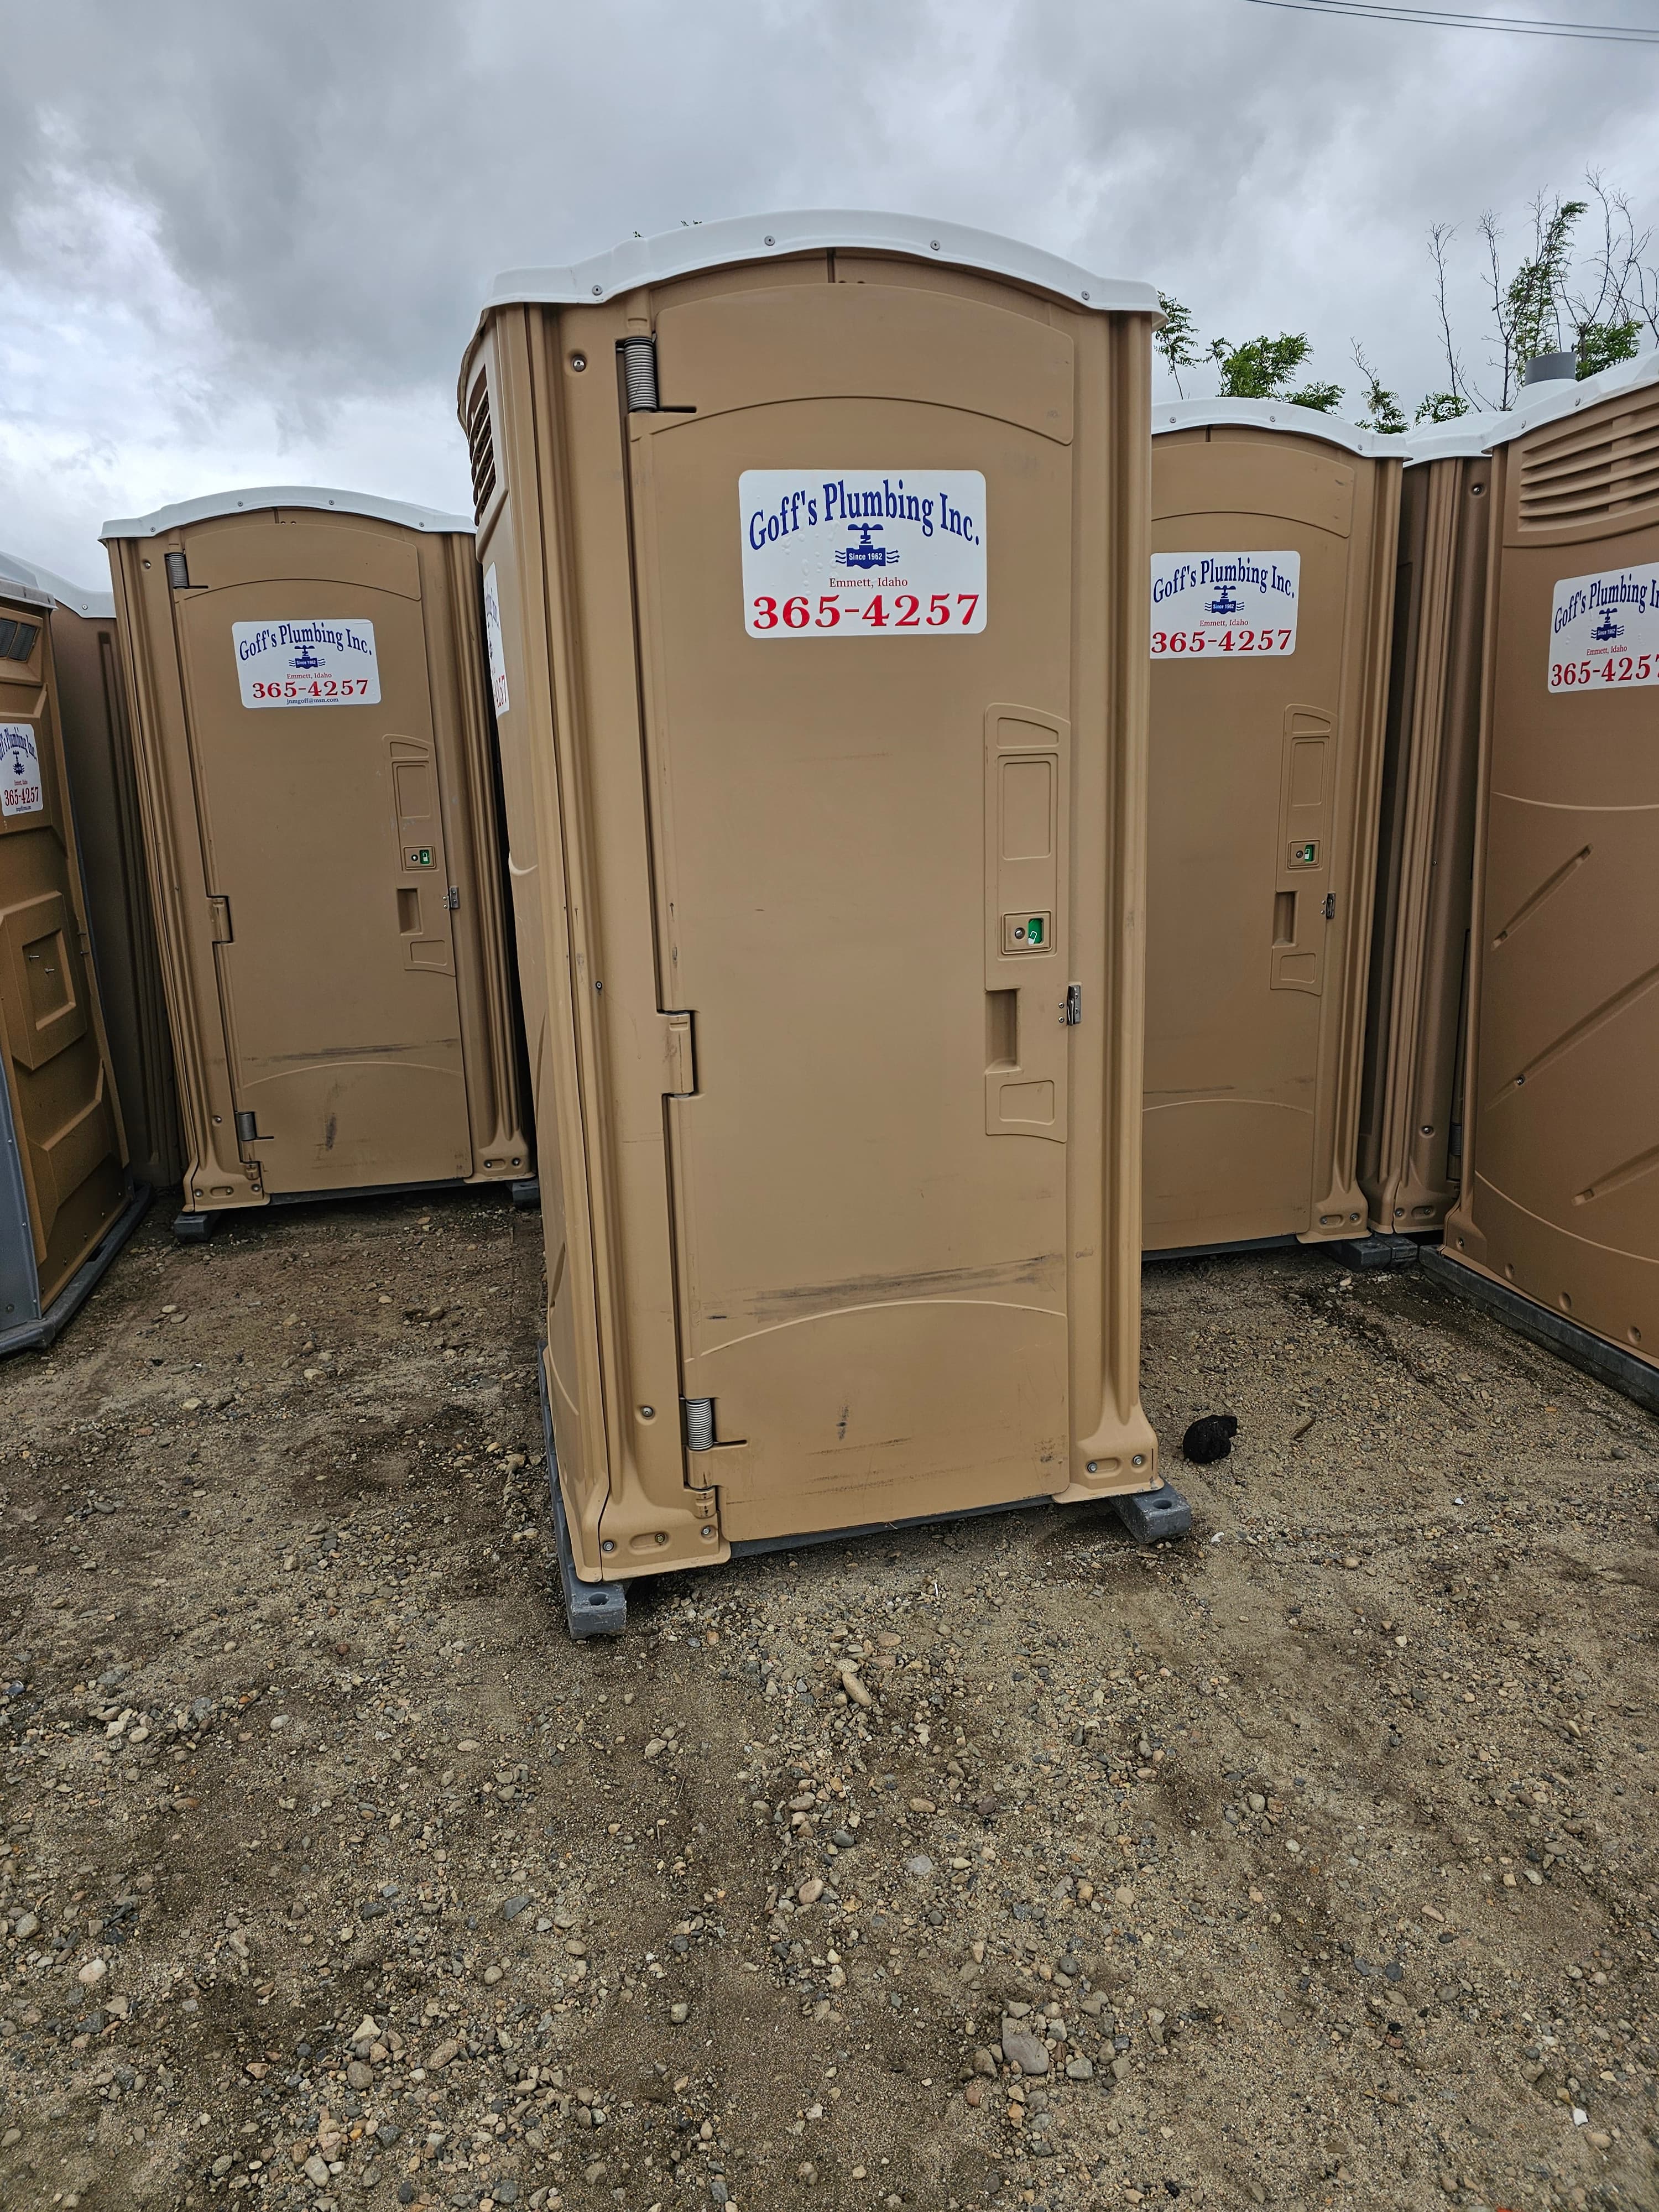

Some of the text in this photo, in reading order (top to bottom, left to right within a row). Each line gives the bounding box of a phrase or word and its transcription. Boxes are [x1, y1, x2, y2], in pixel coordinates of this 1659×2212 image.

[749, 479, 979, 550] Goff's Plumbing Inc.
[849, 552, 883, 561] Since 1962
[830, 577, 908, 588] Emmett, Idaho
[1154, 557, 1294, 603] Goff's Plumbing Inc.
[753, 593, 979, 629] 365-4257
[1554, 590, 1586, 633] Goff's
[1589, 573, 1647, 613] Plumbing
[239, 622, 372, 661] Goff's Plumbing Inc.
[1151, 629, 1292, 653] 365-4257
[1587, 647, 1609, 655] Emmett,
[253, 679, 368, 698] 365-4257
[4, 786, 38, 806] 365-4257
